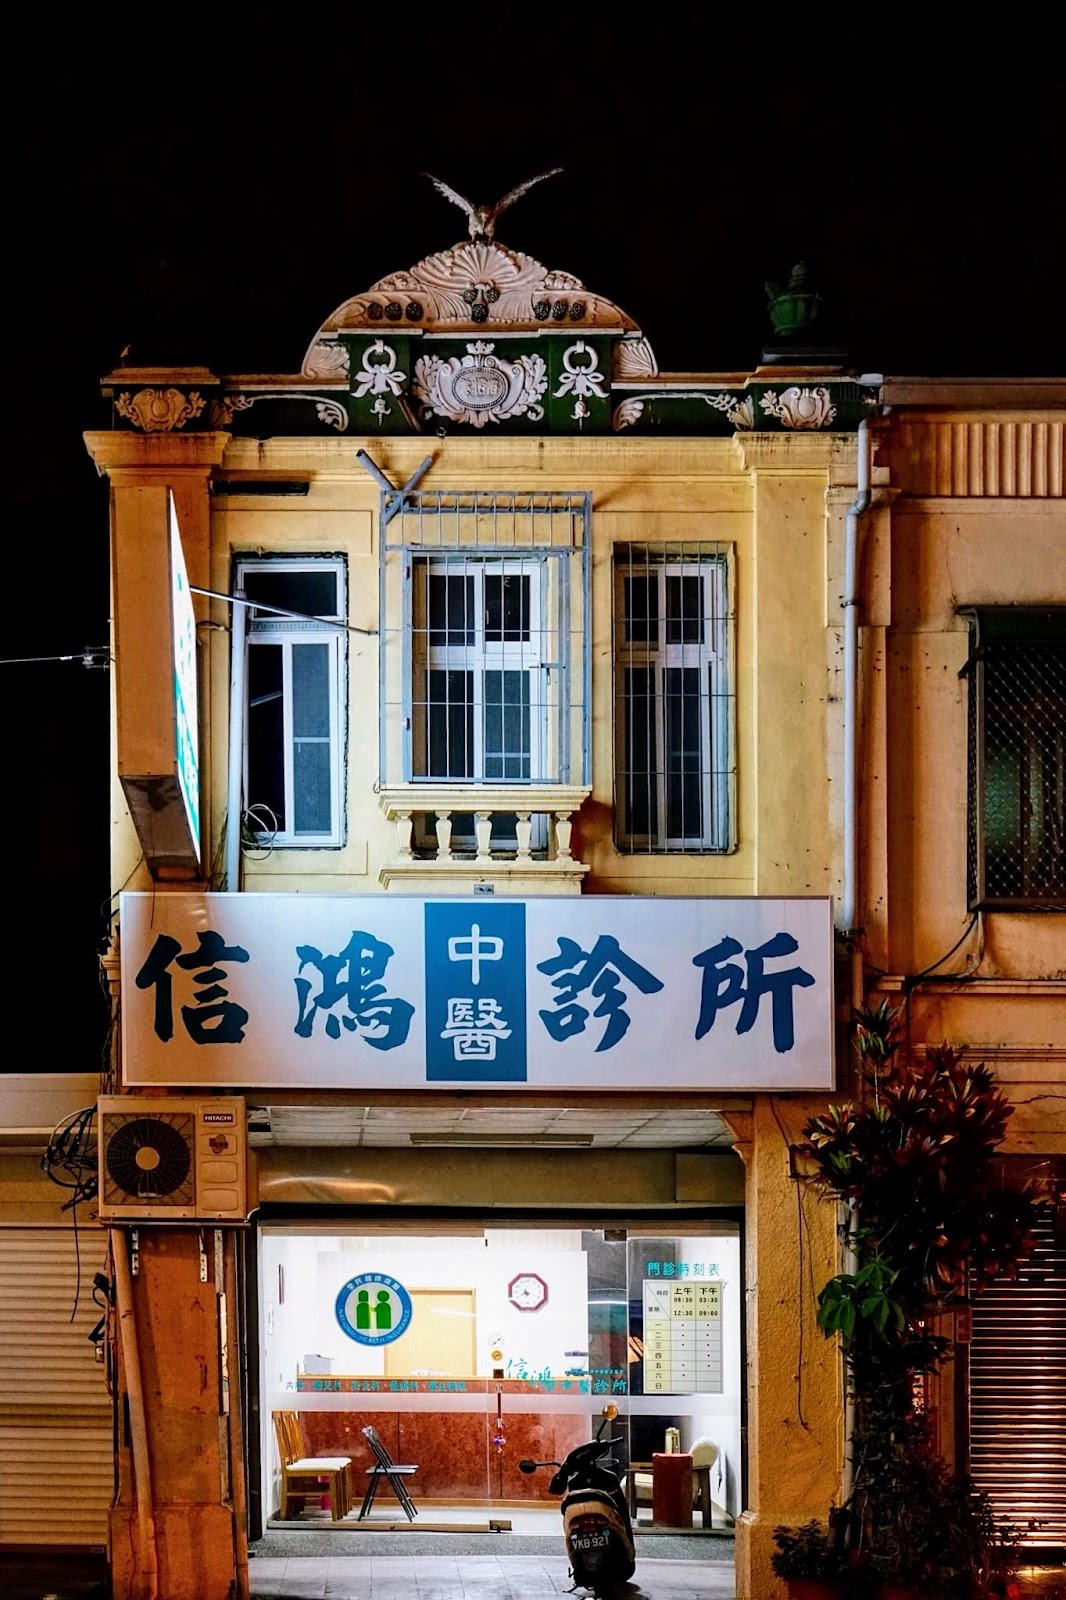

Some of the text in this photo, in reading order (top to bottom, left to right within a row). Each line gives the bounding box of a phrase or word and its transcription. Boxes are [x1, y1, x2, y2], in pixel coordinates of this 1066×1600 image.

[135, 923, 815, 1062] 信鴻 中醫 診所
[647, 1262, 720, 1276] 門診時刻表
[674, 1287, 718, 1295] 上午 下午
[338, 1308, 410, 1344] NATIONAL HEALTH INSURANCE
[655, 1331, 662, 1339] 二
[655, 1352, 662, 1360] 四
[655, 1382, 662, 1390] 日
